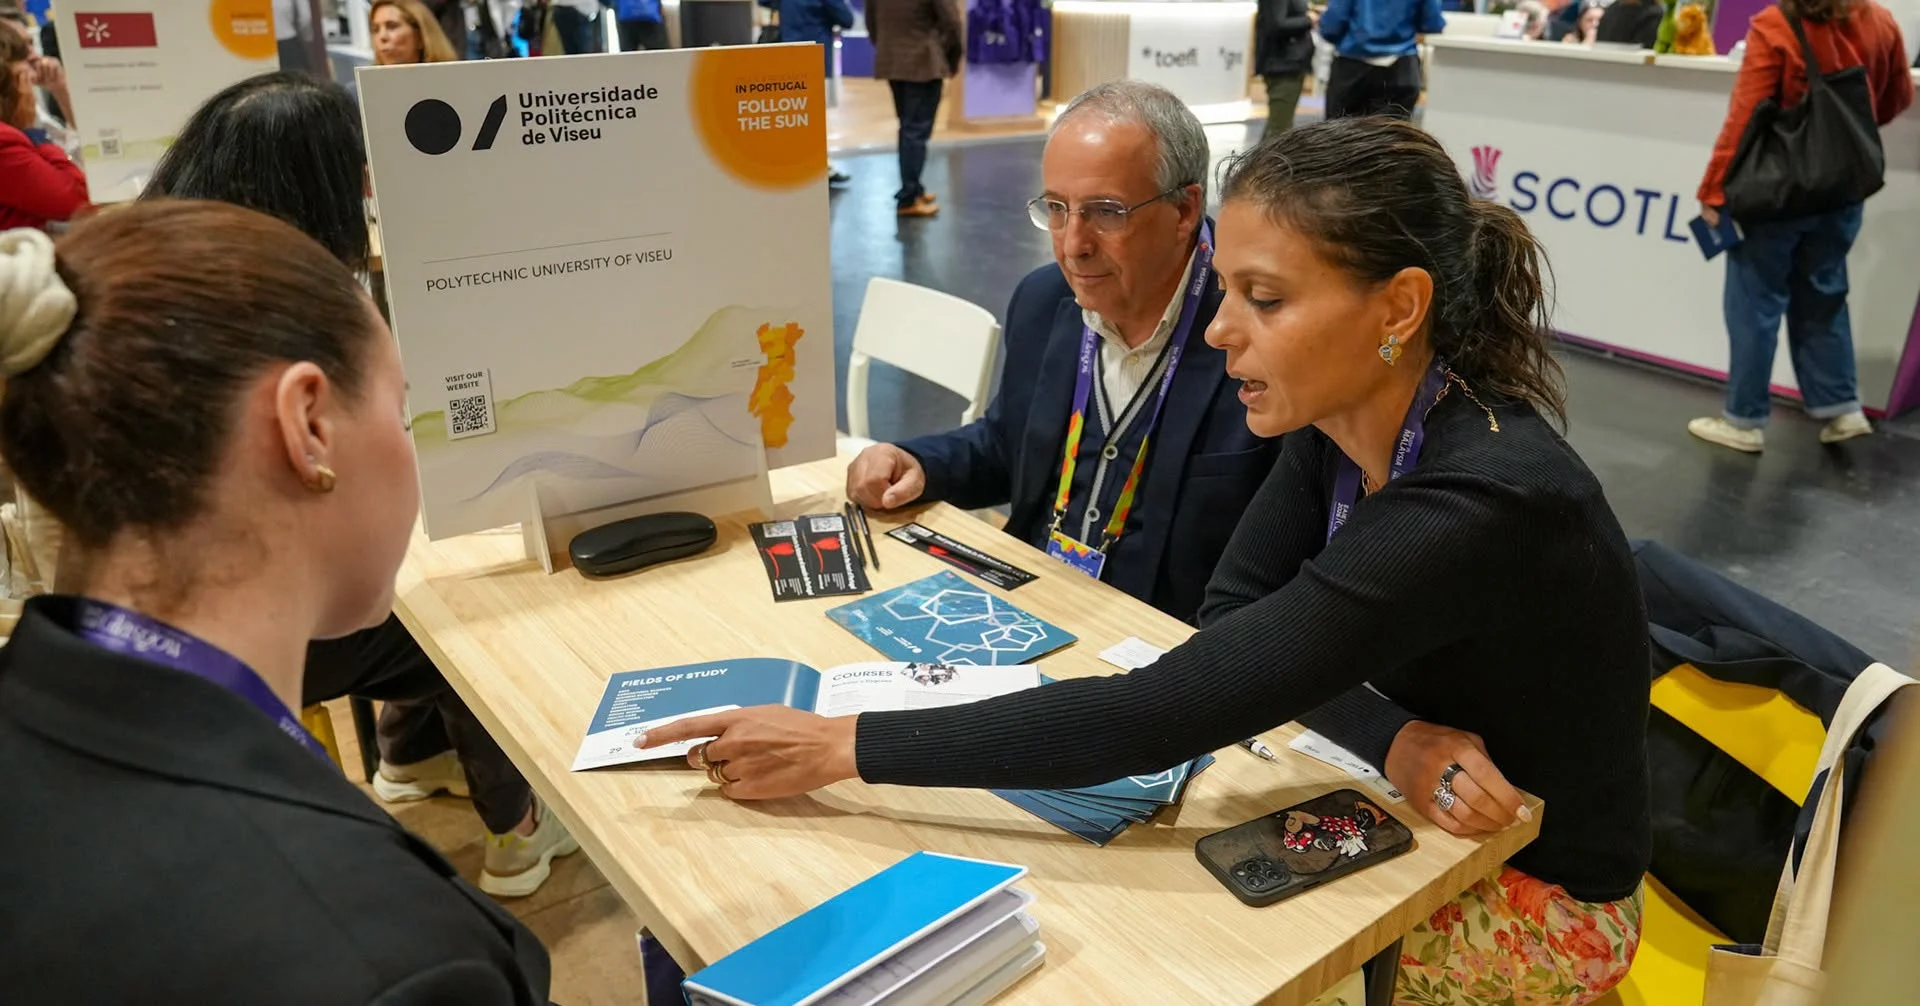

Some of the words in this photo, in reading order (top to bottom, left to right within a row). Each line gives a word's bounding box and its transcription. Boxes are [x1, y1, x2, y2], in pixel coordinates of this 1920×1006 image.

[519, 84, 658, 108] Universidade
[736, 84, 747, 94] IN
[749, 81, 808, 93] PORTUGAL
[738, 97, 808, 114] FOLLOW
[521, 105, 637, 127] Politécnica
[737, 116, 771, 131] THE
[775, 113, 809, 128] SUN
[522, 129, 546, 145] de
[550, 126, 601, 143] Viseu
[1510, 171, 1690, 243] SCOTL
[426, 267, 529, 291] POLYTECHNIC
[532, 256, 611, 278] UNIVERSITY
[614, 253, 633, 267] OF
[635, 249, 673, 264] VISEU
[445, 374, 465, 383] VISIT
[466, 371, 483, 380] OUR
[446, 380, 479, 391] WEBSITE
[1395, 429, 1412, 466] MALAYSIA
[621, 676, 662, 688] FIELDS
[665, 673, 684, 682] OF
[686, 668, 728, 680] STUDY
[832, 670, 893, 681] COURSES
